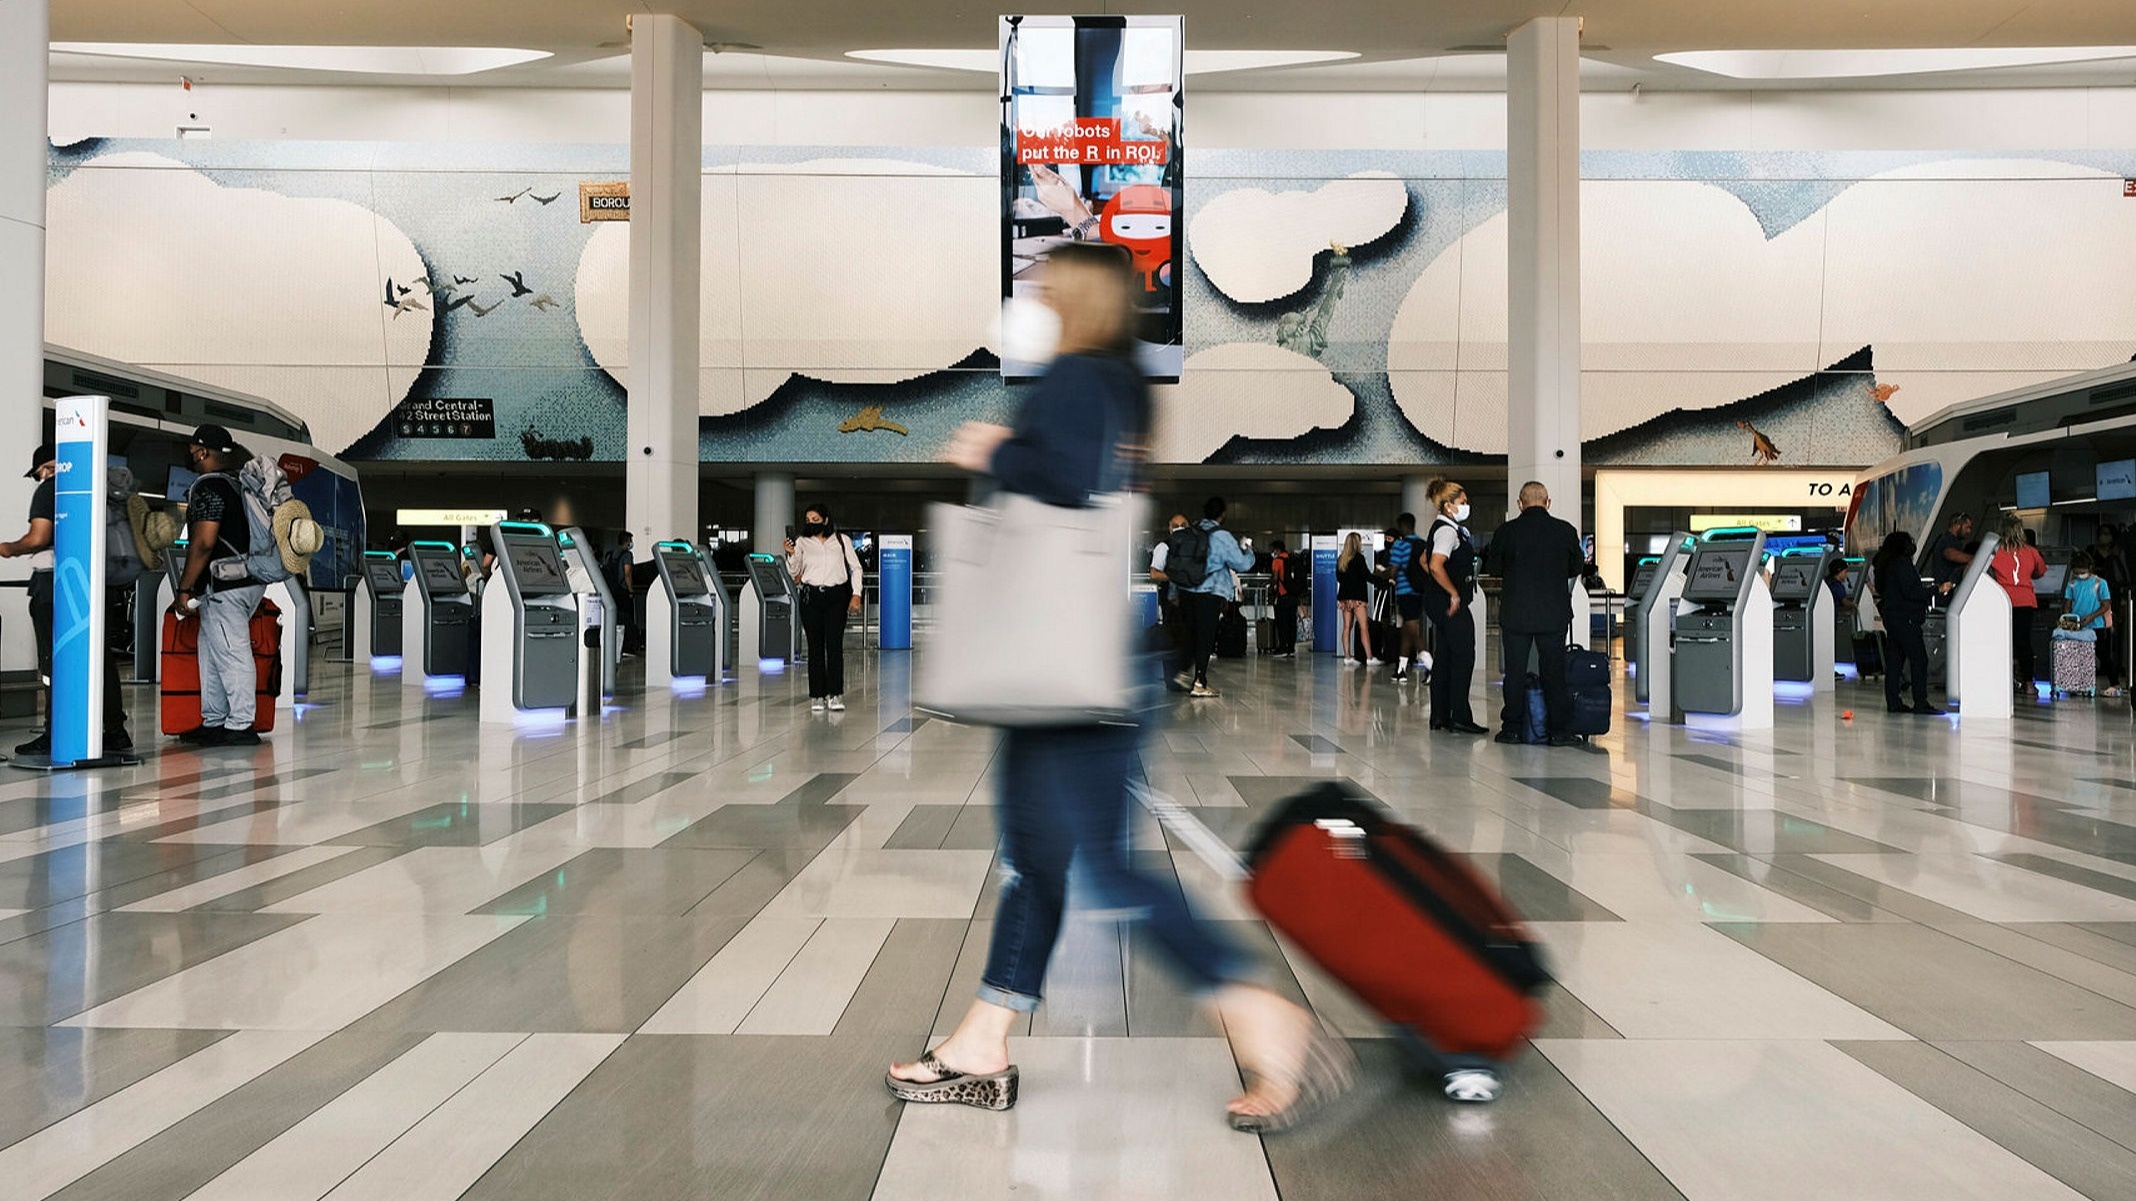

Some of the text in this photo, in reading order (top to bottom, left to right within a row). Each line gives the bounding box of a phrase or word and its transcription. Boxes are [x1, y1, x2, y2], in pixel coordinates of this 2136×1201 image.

[1056, 123, 1111, 138] robots
[1021, 146, 1049, 161] put
[1053, 145, 1080, 159] the
[1086, 145, 1099, 159] R
[1106, 145, 1121, 159] in
[2125, 181, 2136, 193] E
[415, 410, 451, 421] Street
[451, 410, 492, 421] Station
[1808, 483, 1833, 496] TO
[1838, 483, 1851, 496] A
